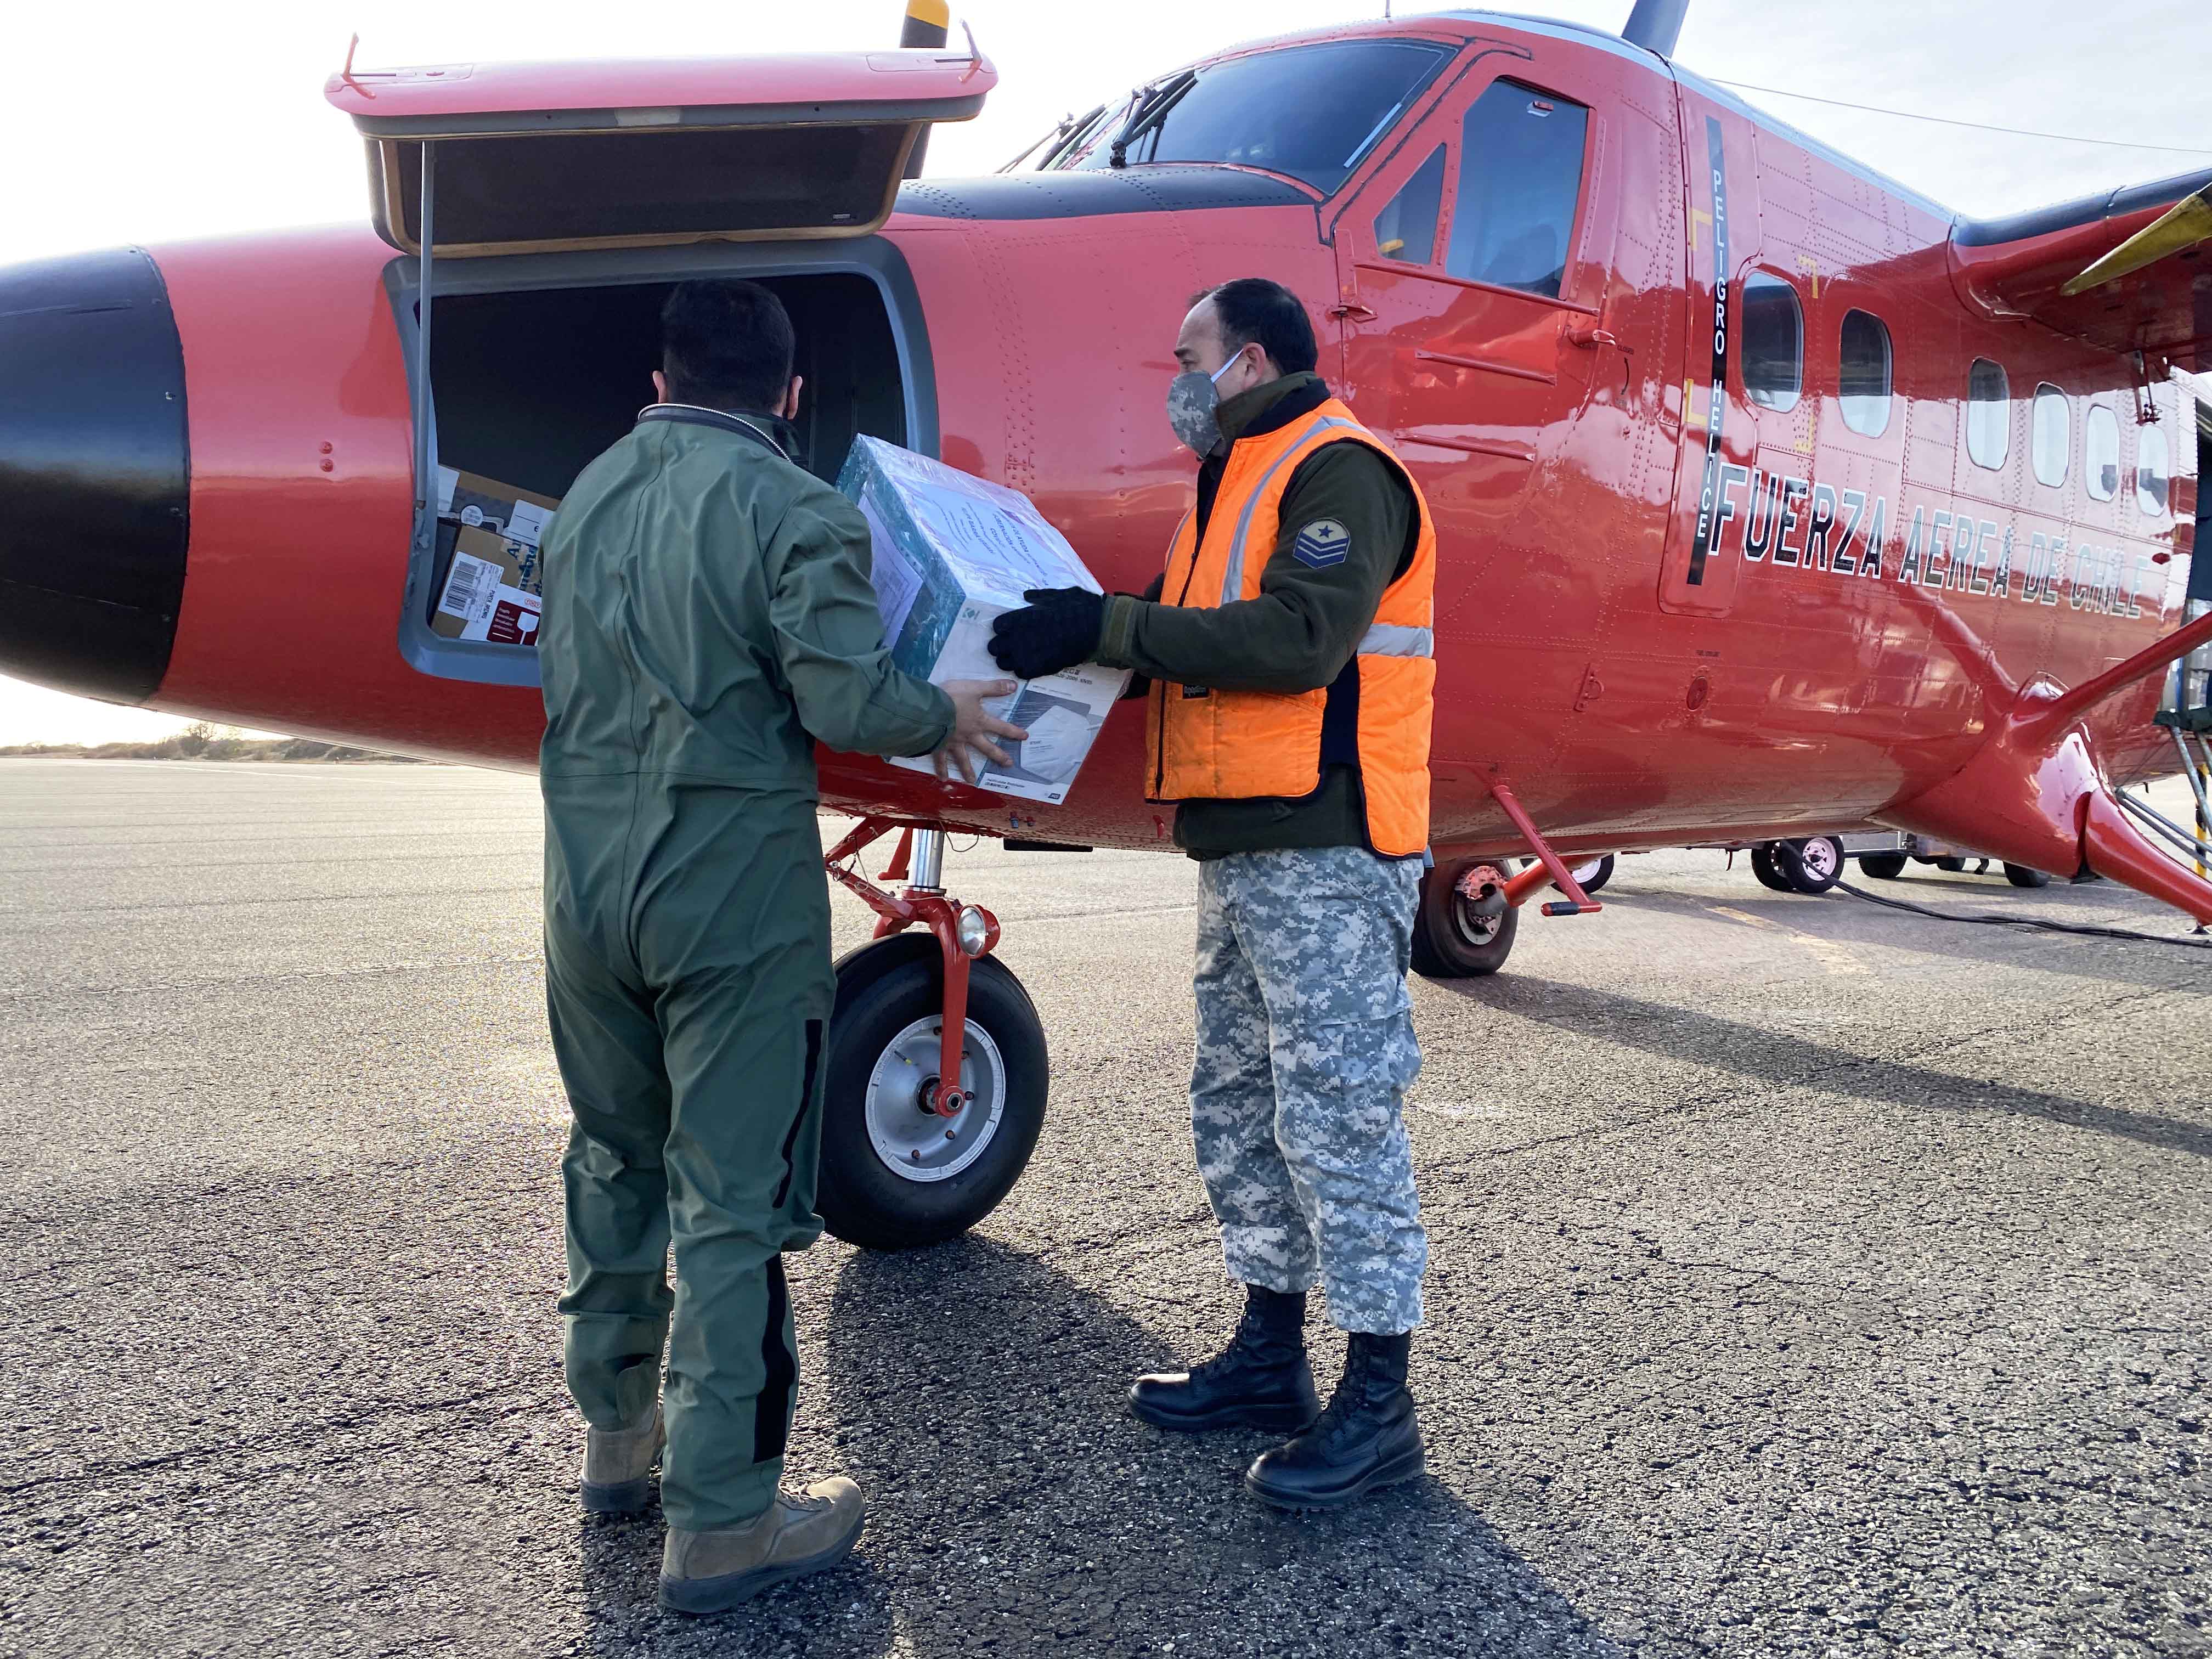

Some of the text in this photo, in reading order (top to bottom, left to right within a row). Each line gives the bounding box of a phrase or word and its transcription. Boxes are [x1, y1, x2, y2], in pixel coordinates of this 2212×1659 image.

[1696, 168, 1726, 538] PELIGRO HELICE
[1708, 462, 2149, 619] FUERZA AEREA DE CHILE
